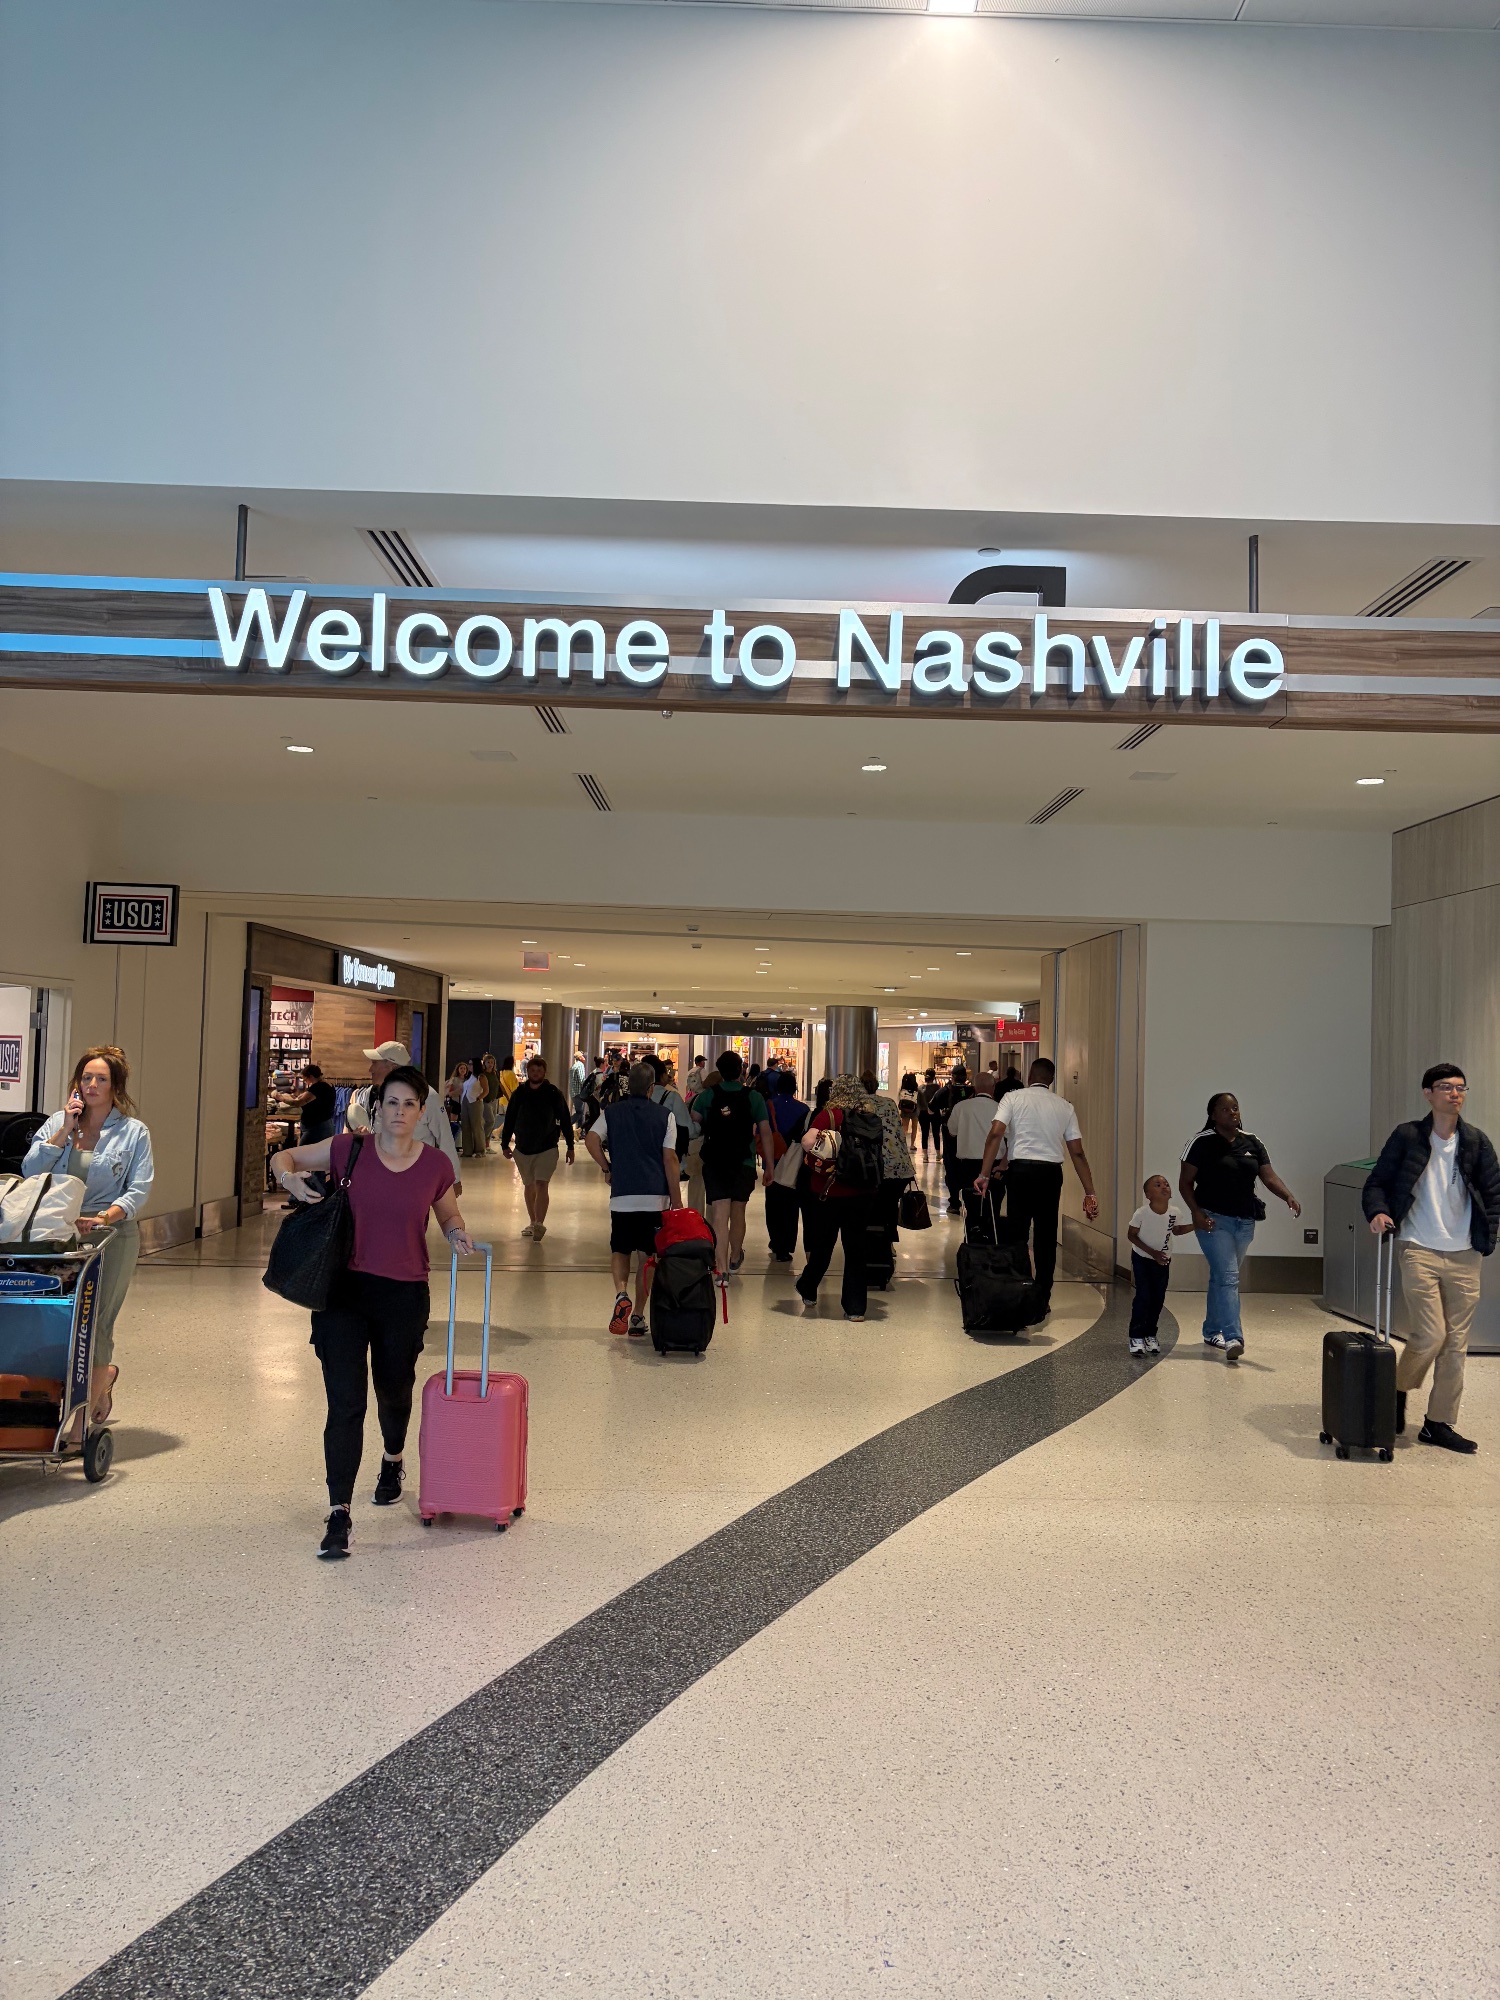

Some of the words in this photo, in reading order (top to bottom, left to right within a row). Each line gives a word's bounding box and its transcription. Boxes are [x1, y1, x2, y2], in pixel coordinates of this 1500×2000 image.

[207, 587, 670, 684] Welcome
[703, 608, 797, 693] to
[837, 608, 1286, 701] Nashville
[113, 901, 153, 928] USO
[0, 1043, 15, 1074] USO
